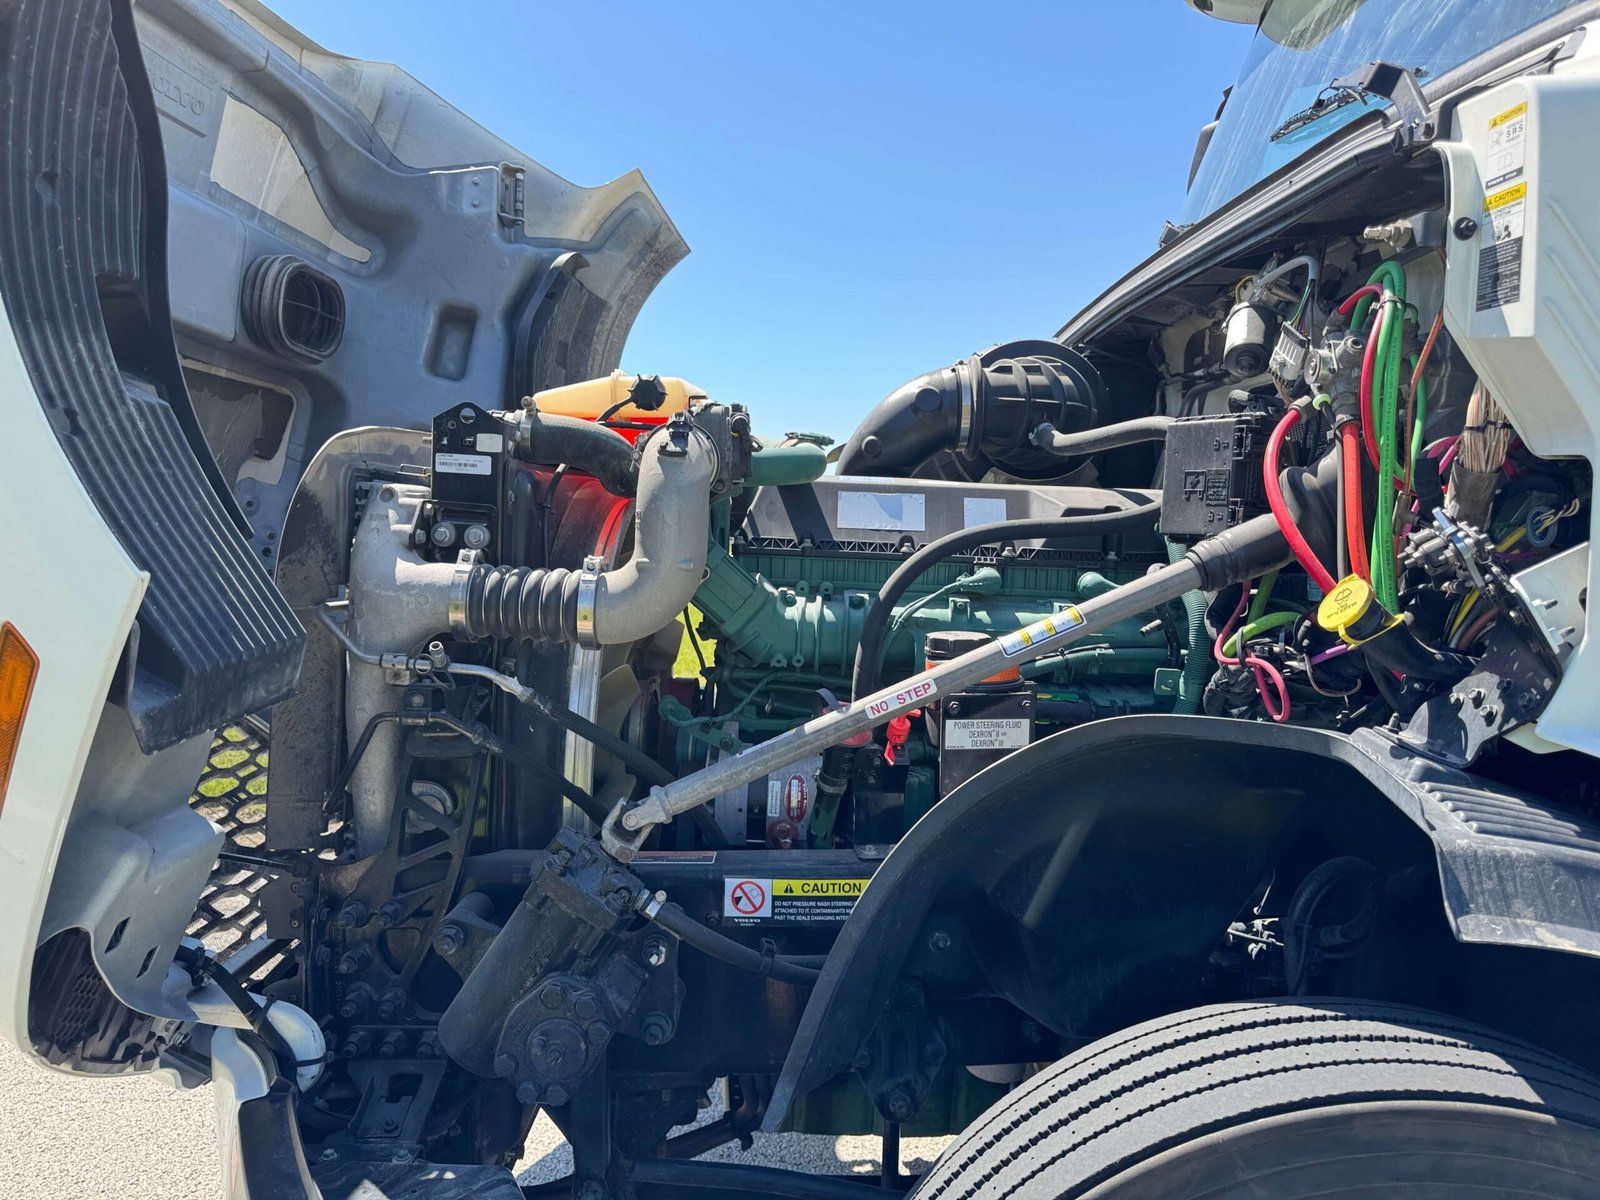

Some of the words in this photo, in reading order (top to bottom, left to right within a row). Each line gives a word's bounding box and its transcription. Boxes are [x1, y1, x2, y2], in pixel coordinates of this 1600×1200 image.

[153, 75, 205, 116] OLVO
[1500, 106, 1523, 122] CAUTION
[1494, 187, 1521, 203] CAUTION
[870, 700, 889, 716] NO
[896, 682, 931, 705] STEP
[954, 721, 975, 730] POWER
[976, 721, 1004, 730] STEERING
[1005, 721, 1022, 729] FLUID
[801, 882, 862, 894] CAUTION
